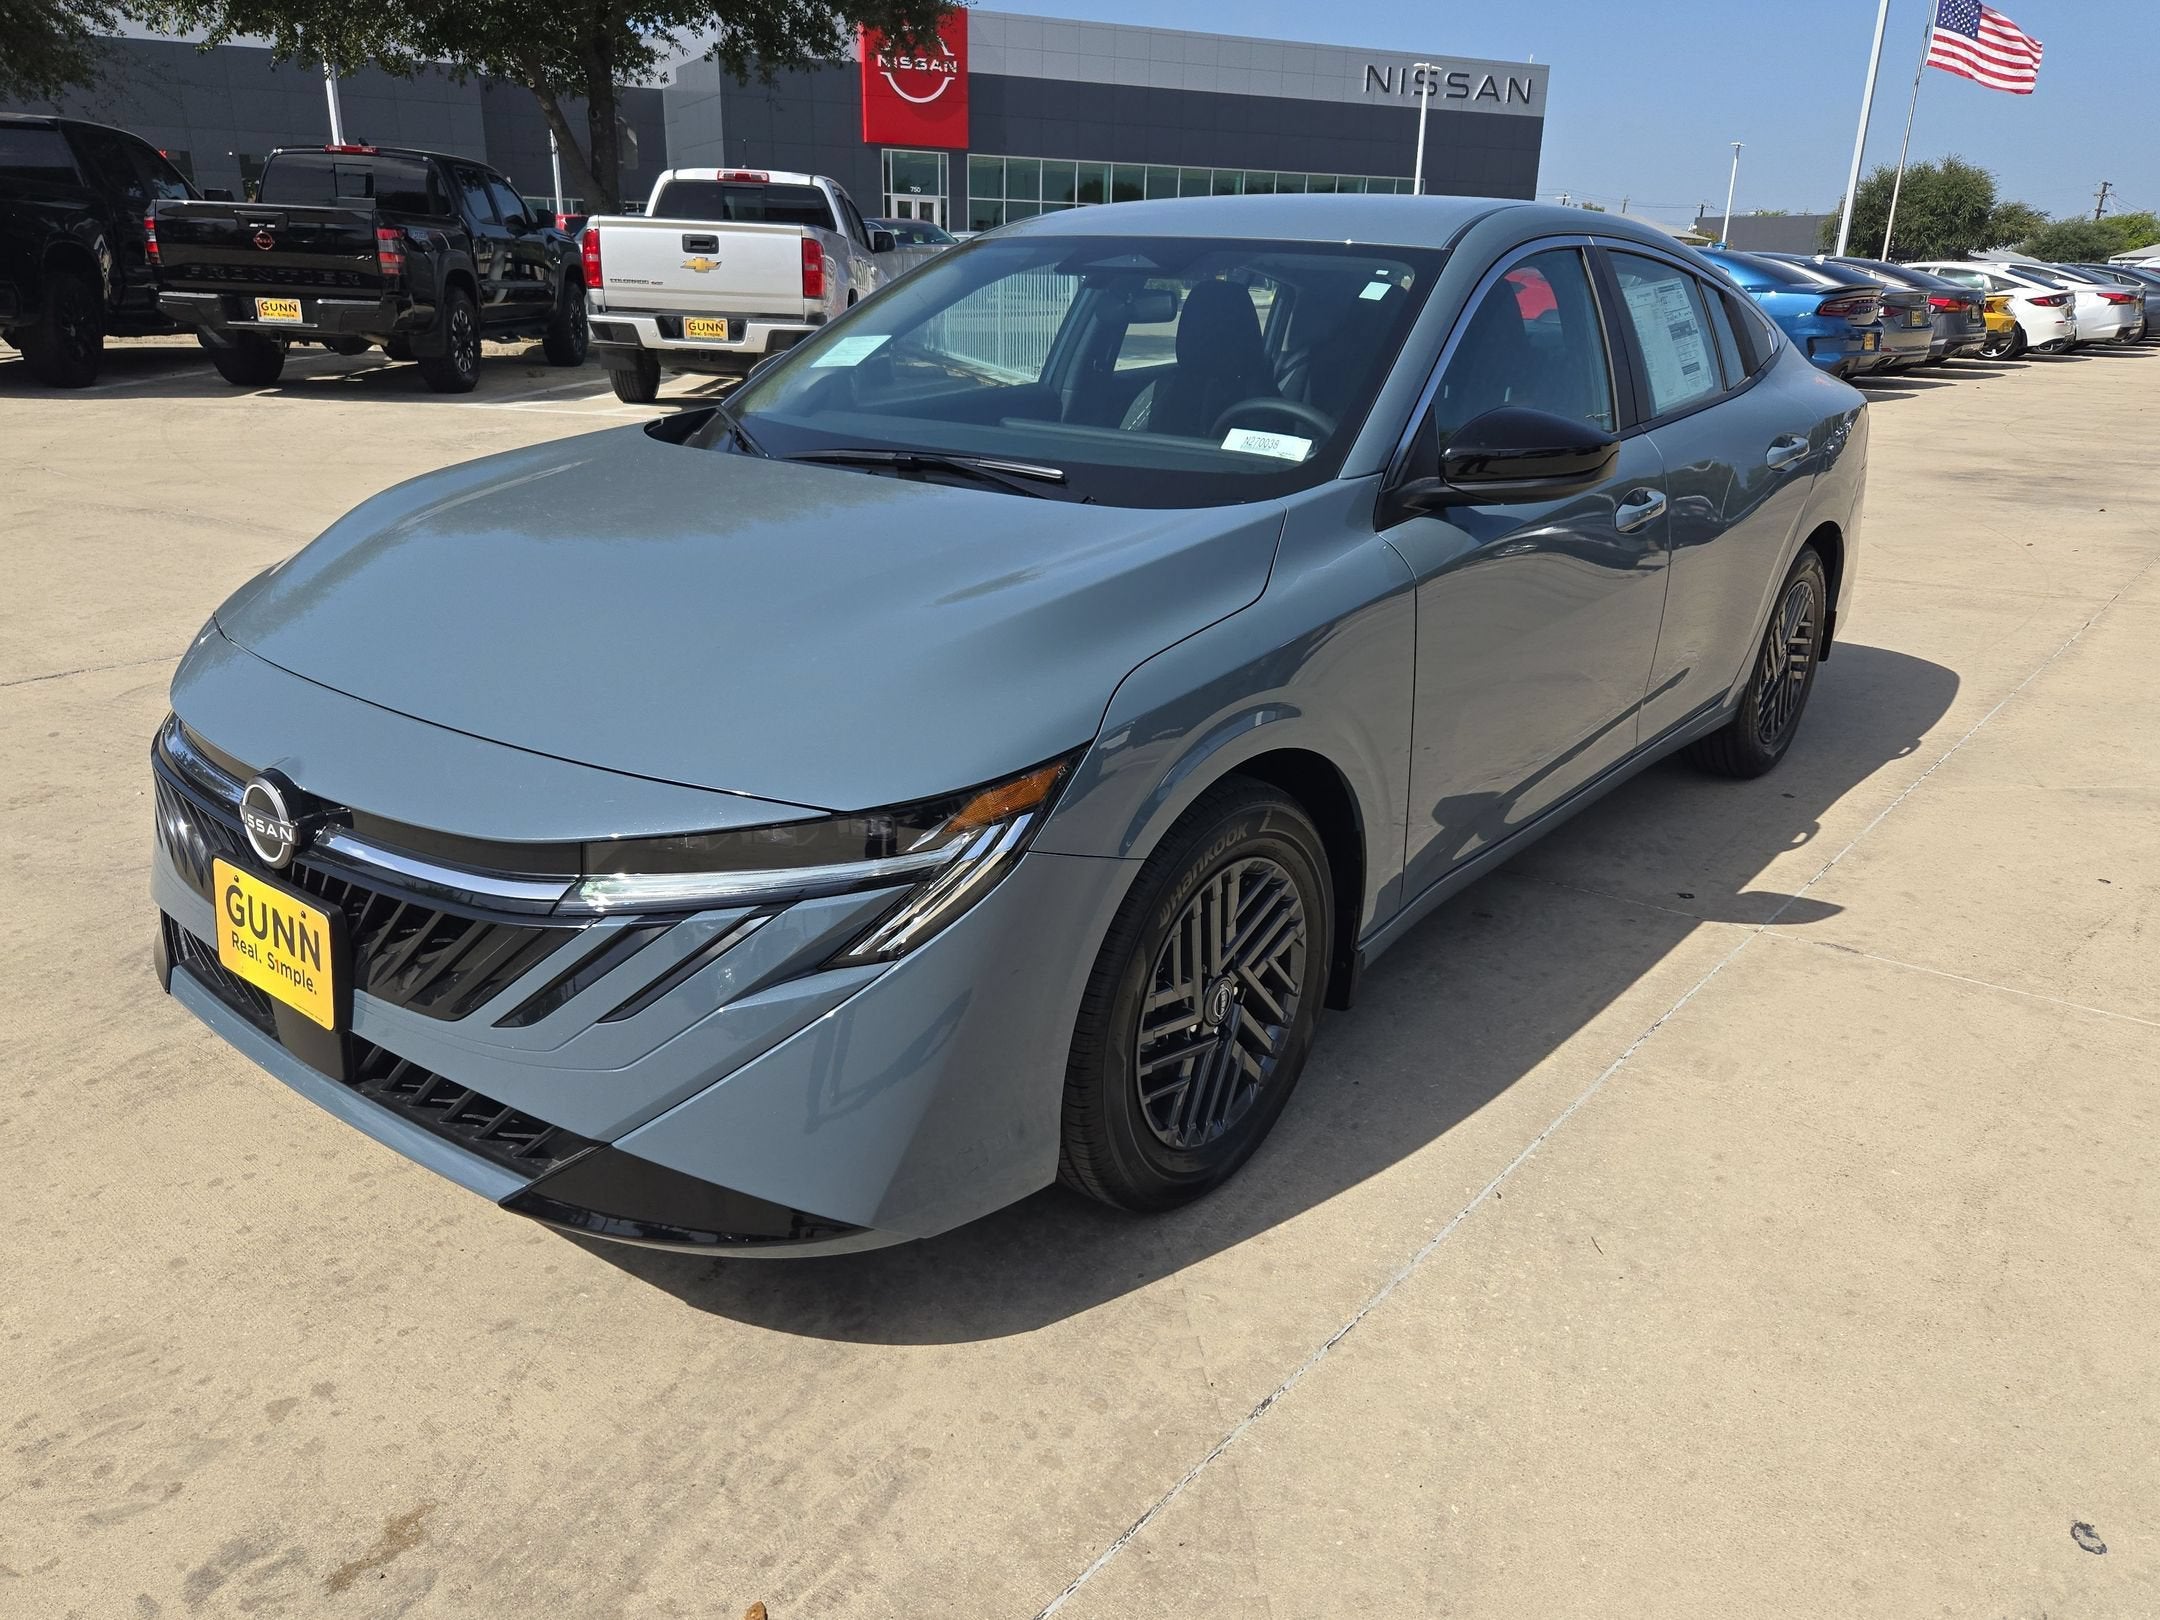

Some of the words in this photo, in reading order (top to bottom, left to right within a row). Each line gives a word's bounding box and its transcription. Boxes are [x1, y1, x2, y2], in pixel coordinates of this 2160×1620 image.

[877, 54, 957, 73] NISSAN
[1364, 64, 1532, 105] NISSAN
[261, 301, 298, 313] GUNN
[688, 322, 724, 332] GUNN
[240, 806, 293, 842] ISSAN
[225, 884, 321, 973] GUNN
[231, 930, 262, 964] Real.
